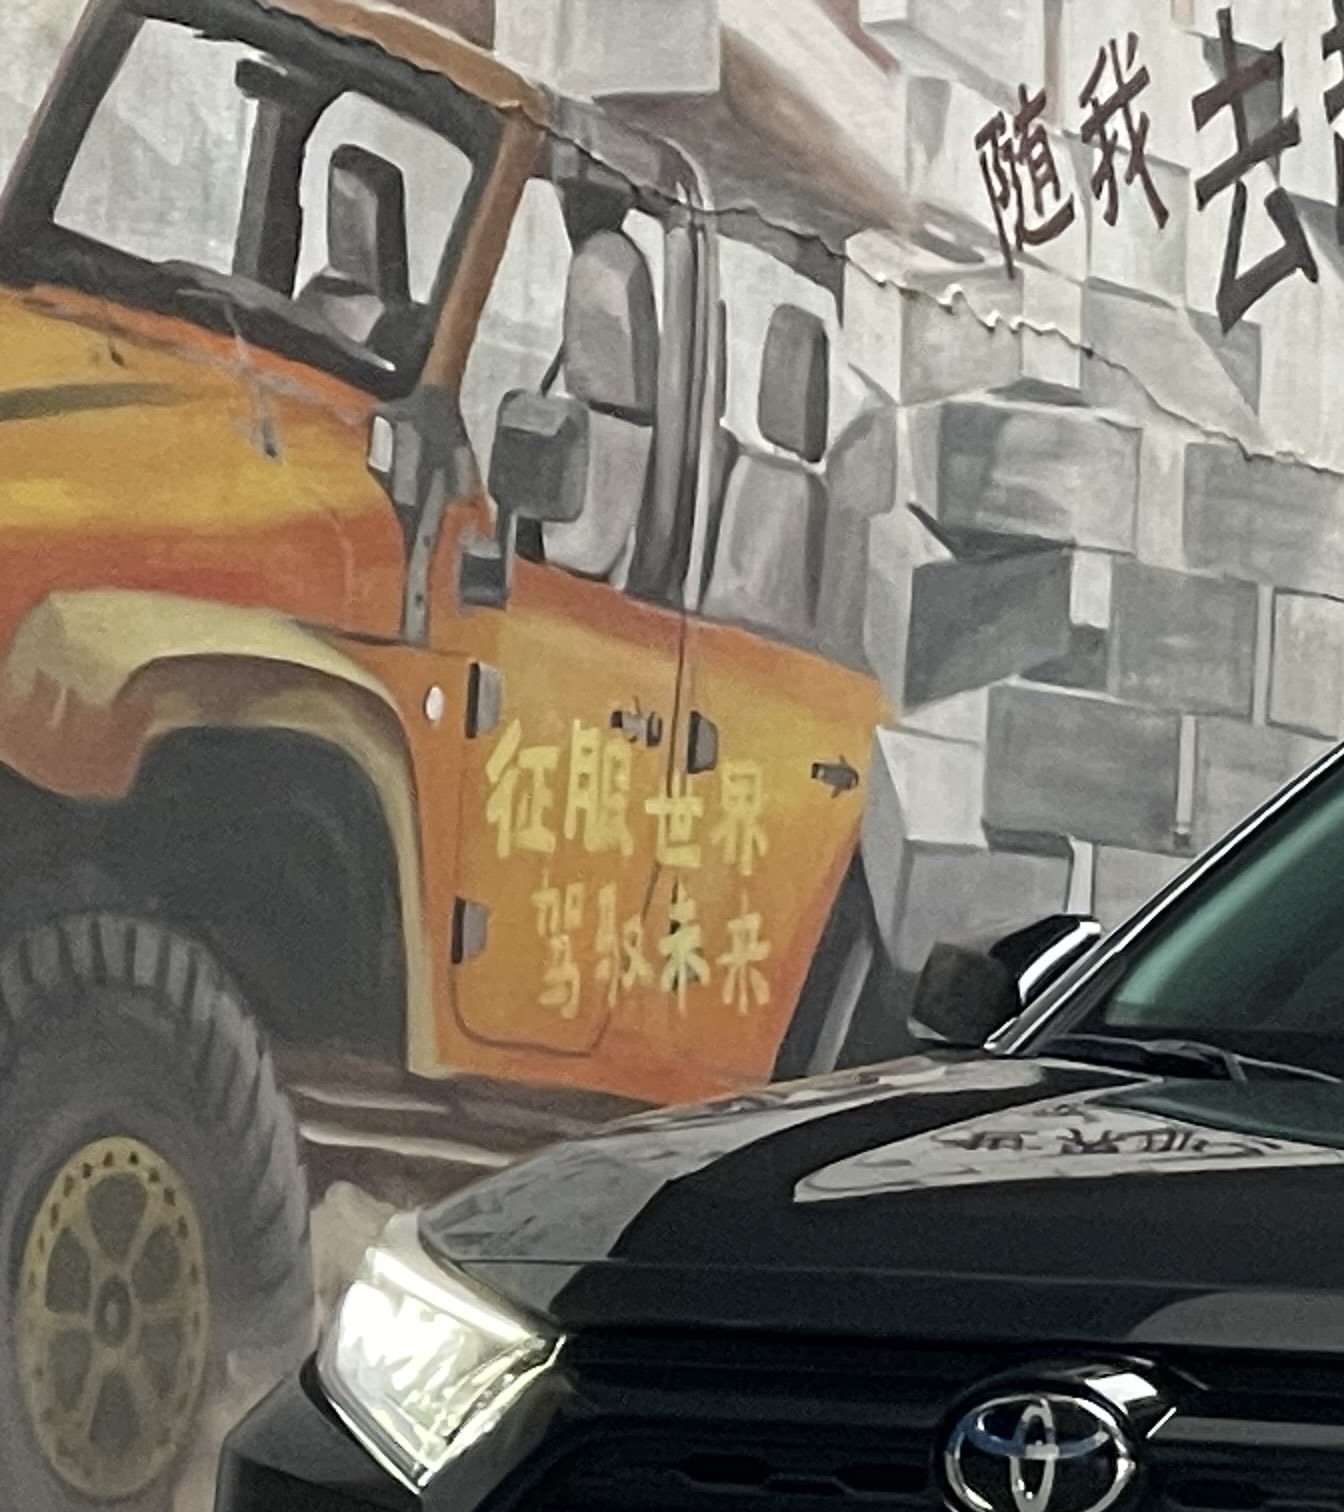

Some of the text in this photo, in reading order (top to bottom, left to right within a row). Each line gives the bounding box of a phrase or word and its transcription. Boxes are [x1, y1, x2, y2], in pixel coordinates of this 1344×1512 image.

[485, 719, 769, 876] 征服世界
[531, 867, 771, 1018] 驾驭未来
